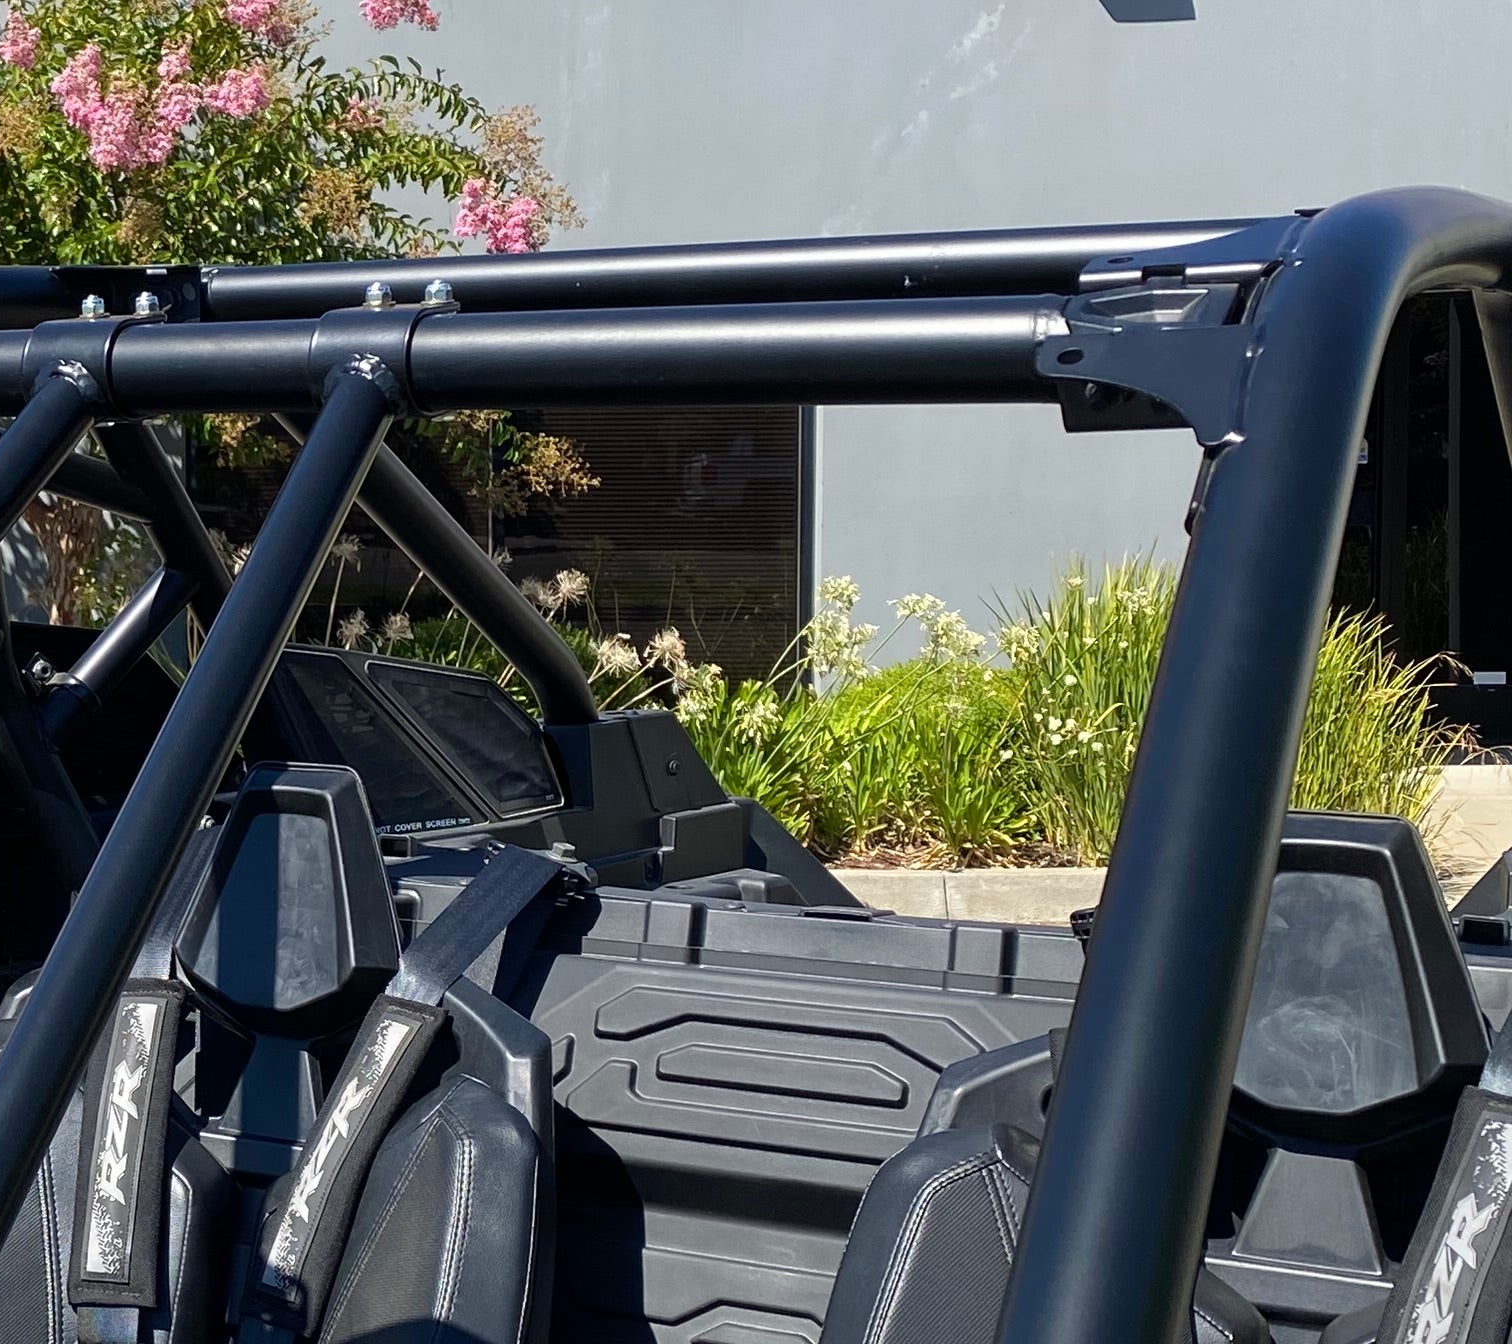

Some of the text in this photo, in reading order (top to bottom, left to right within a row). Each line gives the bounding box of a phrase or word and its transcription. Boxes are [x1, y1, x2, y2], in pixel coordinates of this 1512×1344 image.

[394, 821, 423, 832] COVER
[425, 817, 457, 828] SCREEN
[98, 1060, 144, 1205] RZR
[289, 1076, 371, 1223] RZR
